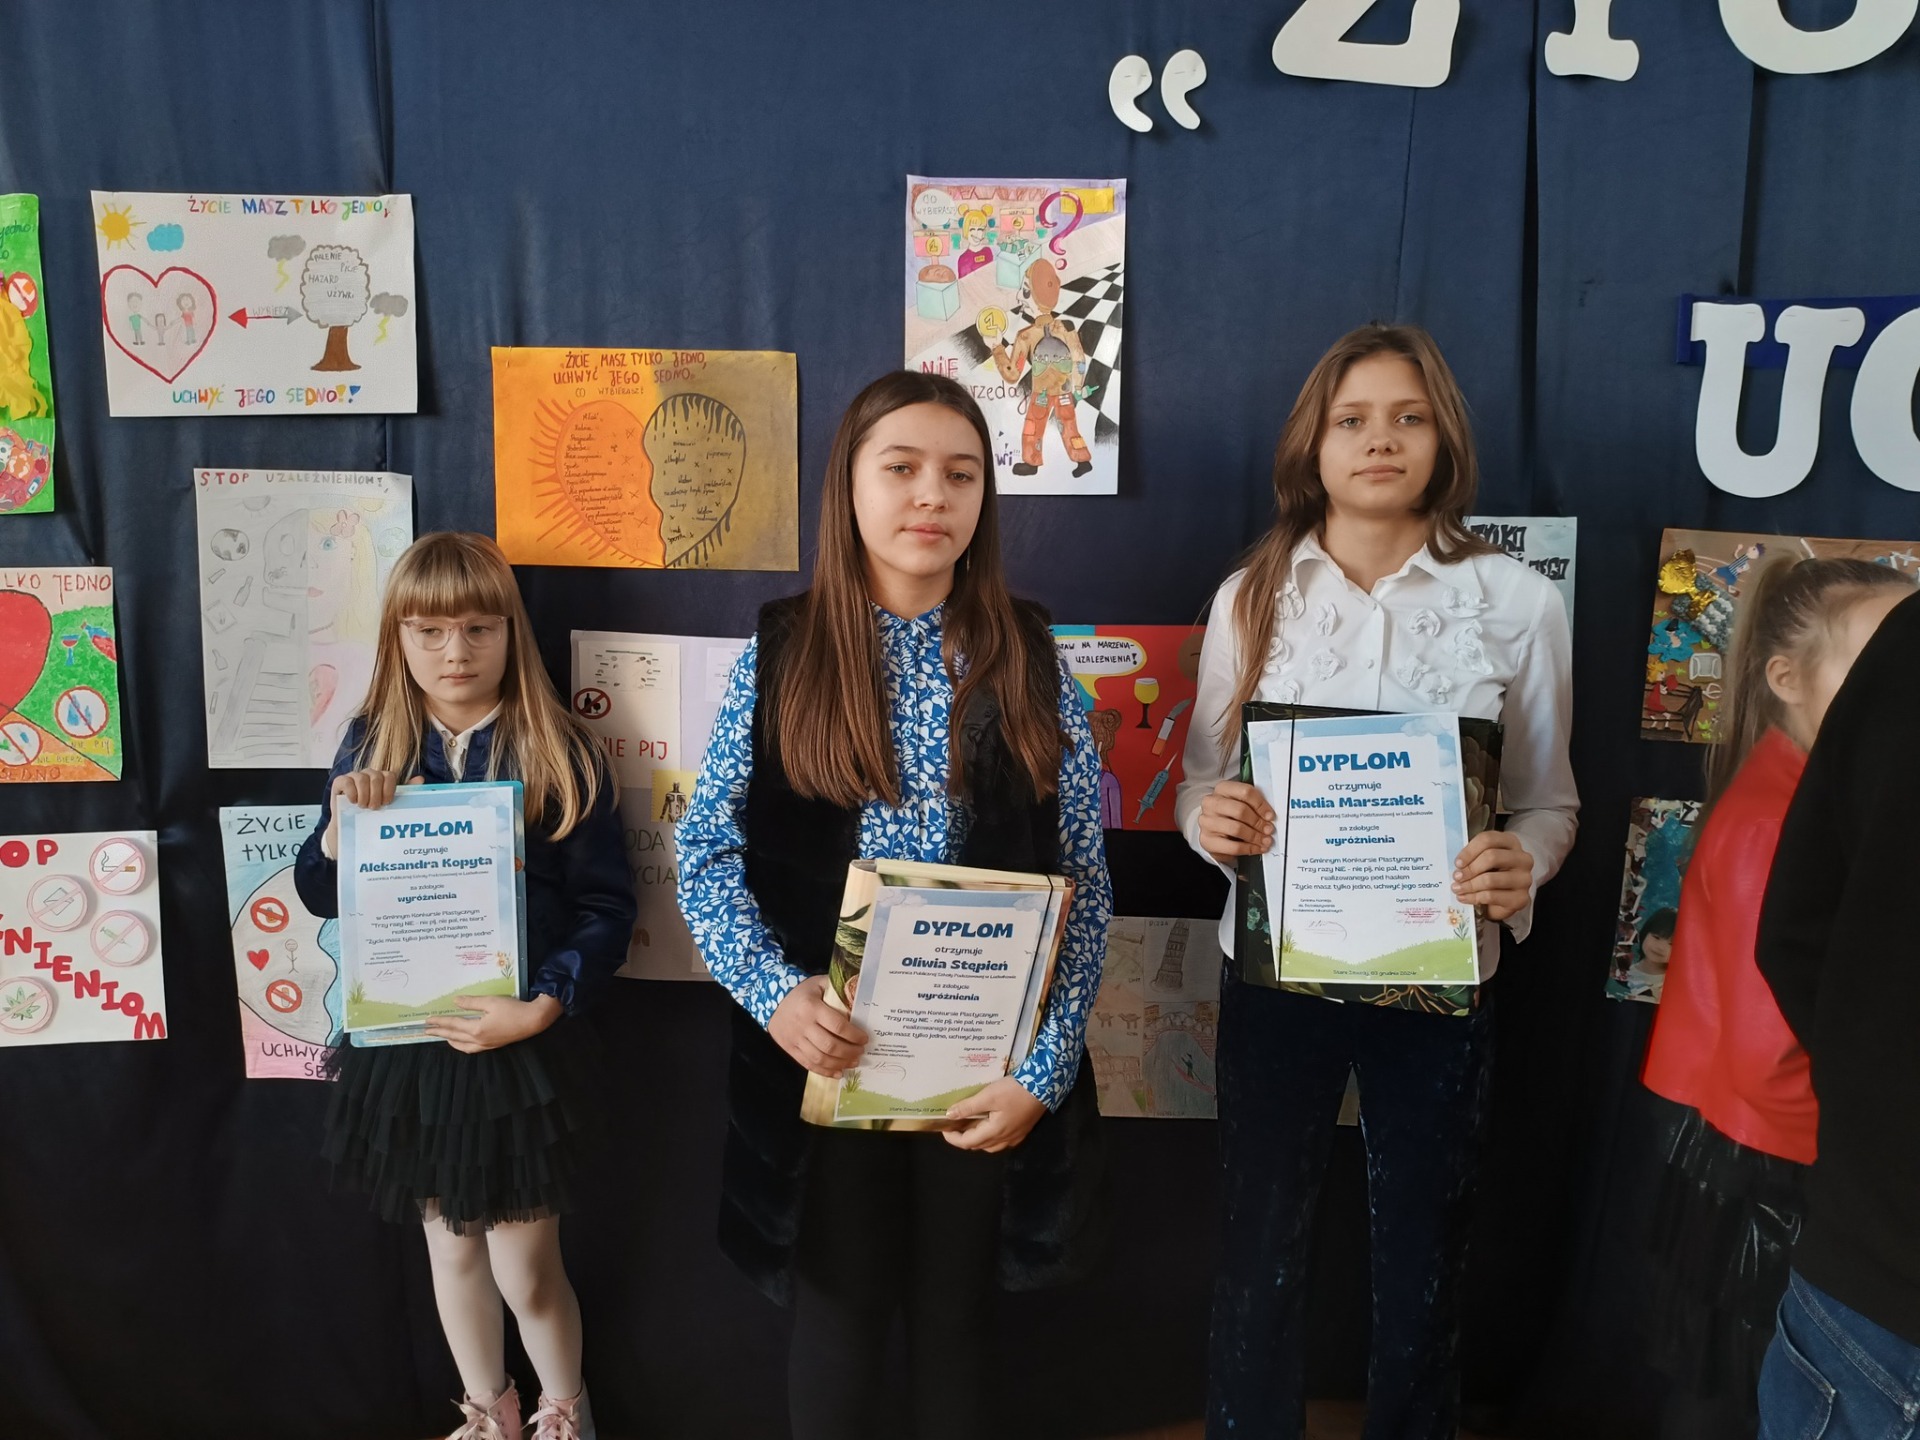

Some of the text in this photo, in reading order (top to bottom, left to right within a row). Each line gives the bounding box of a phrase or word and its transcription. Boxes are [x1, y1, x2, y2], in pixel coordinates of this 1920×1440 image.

[188, 196, 231, 214] ŻYCIE
[242, 199, 288, 215] MASZ
[308, 274, 338, 284] HAZARD
[600, 353, 628, 367] MASZ
[631, 352, 663, 366] TYLKO
[609, 370, 640, 386] JEGO
[173, 384, 225, 410] UCHWYĆ
[235, 388, 275, 408] JEGO
[201, 472, 249, 486] STOP
[52, 574, 111, 605] JEDNO
[639, 740, 668, 760] PIJ
[1298, 751, 1410, 772] DYPLOM
[1328, 782, 1381, 792] otrzymuje
[1291, 794, 1424, 808] Nadia Marszałek
[237, 813, 306, 834] ŻYCIE
[380, 820, 473, 839] DYPLOM
[1325, 835, 1395, 846] wyróżnienia
[403, 846, 448, 855] otrzymuje
[360, 856, 492, 872] Aleksandra Kopyta
[398, 892, 457, 904] wyróżnienia
[913, 920, 1013, 938] DYPLOM
[934, 947, 983, 955] otrzymuje
[902, 957, 1008, 973] Oliwia Stępień
[0, 913, 166, 1039] NIENIOM
[918, 992, 980, 1001] wyróżnienia
